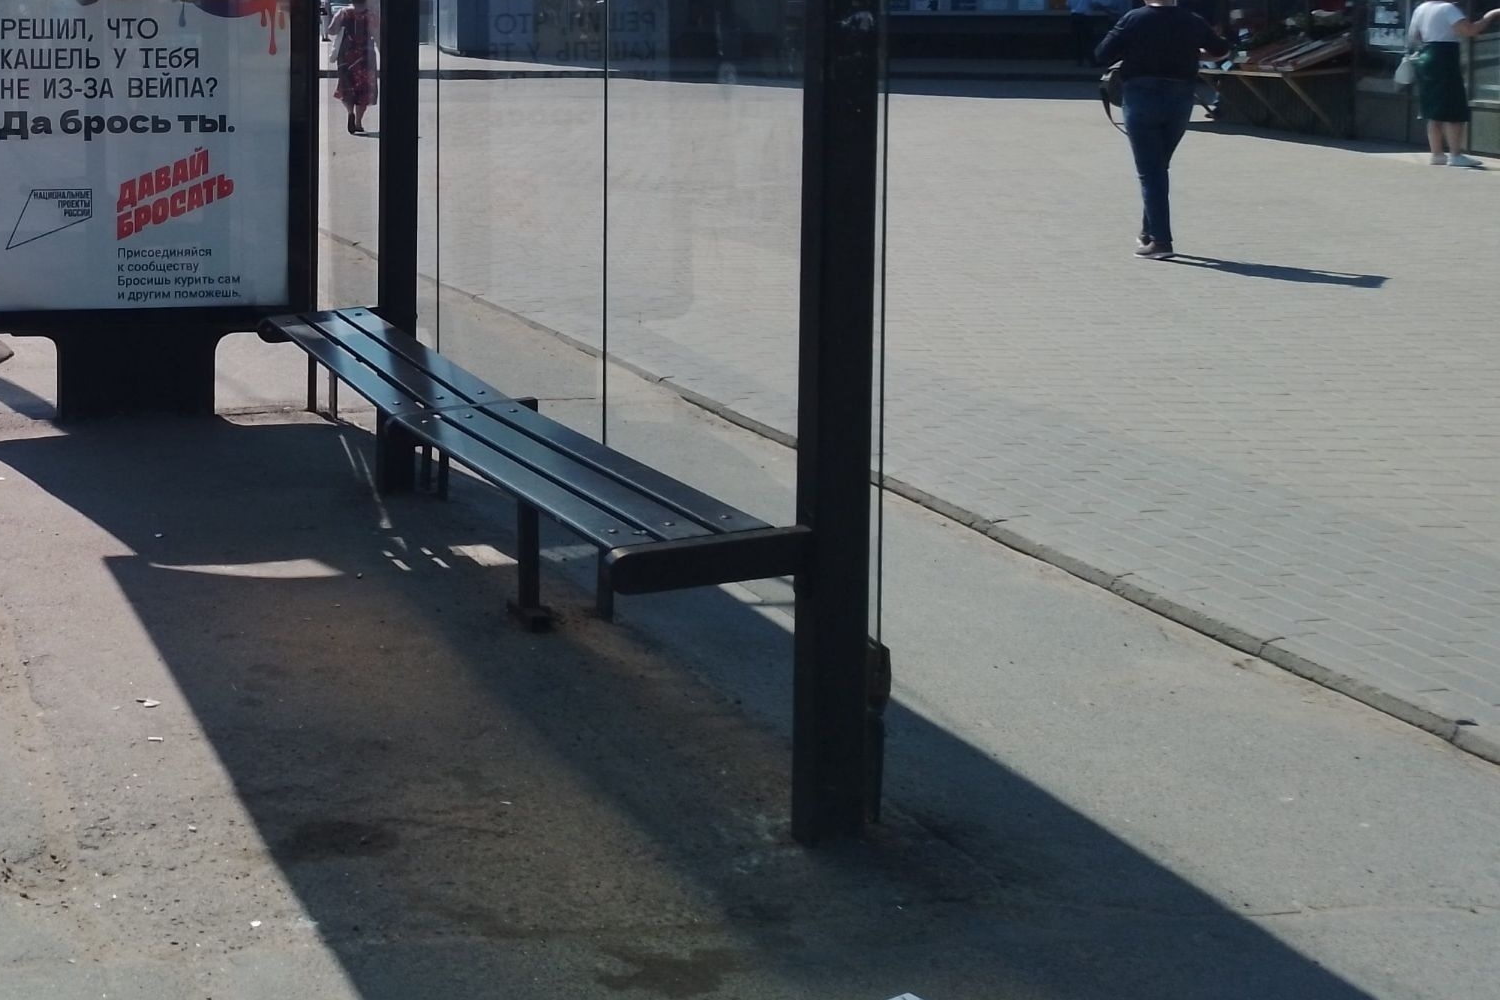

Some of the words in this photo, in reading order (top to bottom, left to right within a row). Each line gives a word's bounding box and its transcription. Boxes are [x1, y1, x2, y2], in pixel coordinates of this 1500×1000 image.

[0, 18, 93, 41] РЕШИЛ,
[107, 18, 158, 39] ЧТО
[0, 48, 100, 69] КАШЕЛЬ
[114, 48, 126, 69] У
[1, 78, 29, 99] НЕ
[44, 77, 114, 99] ИЗ-ЗА
[128, 72, 218, 98] ВЕЙПА?
[0, 110, 52, 140] Да
[60, 109, 171, 141] брось
[178, 114, 235, 133] ты.
[116, 146, 209, 213] ДАВАЙ
[33, 190, 90, 200] НАЦИОНАЛЬНЫЕ
[57, 200, 90, 209] ПРОЕКТЫ
[116, 174, 235, 241] БРОСАТЬ
[63, 209, 90, 217] РОССИИ
[117, 247, 212, 260] Присоединяйся
[117, 262, 124, 271] к
[127, 261, 199, 274] сообществу
[117, 275, 171, 288] Бросишь
[174, 276, 215, 288] курить
[217, 275, 241, 284] сам
[117, 292, 125, 300] и
[127, 290, 171, 302] другим
[174, 288, 242, 299] поможешь.
